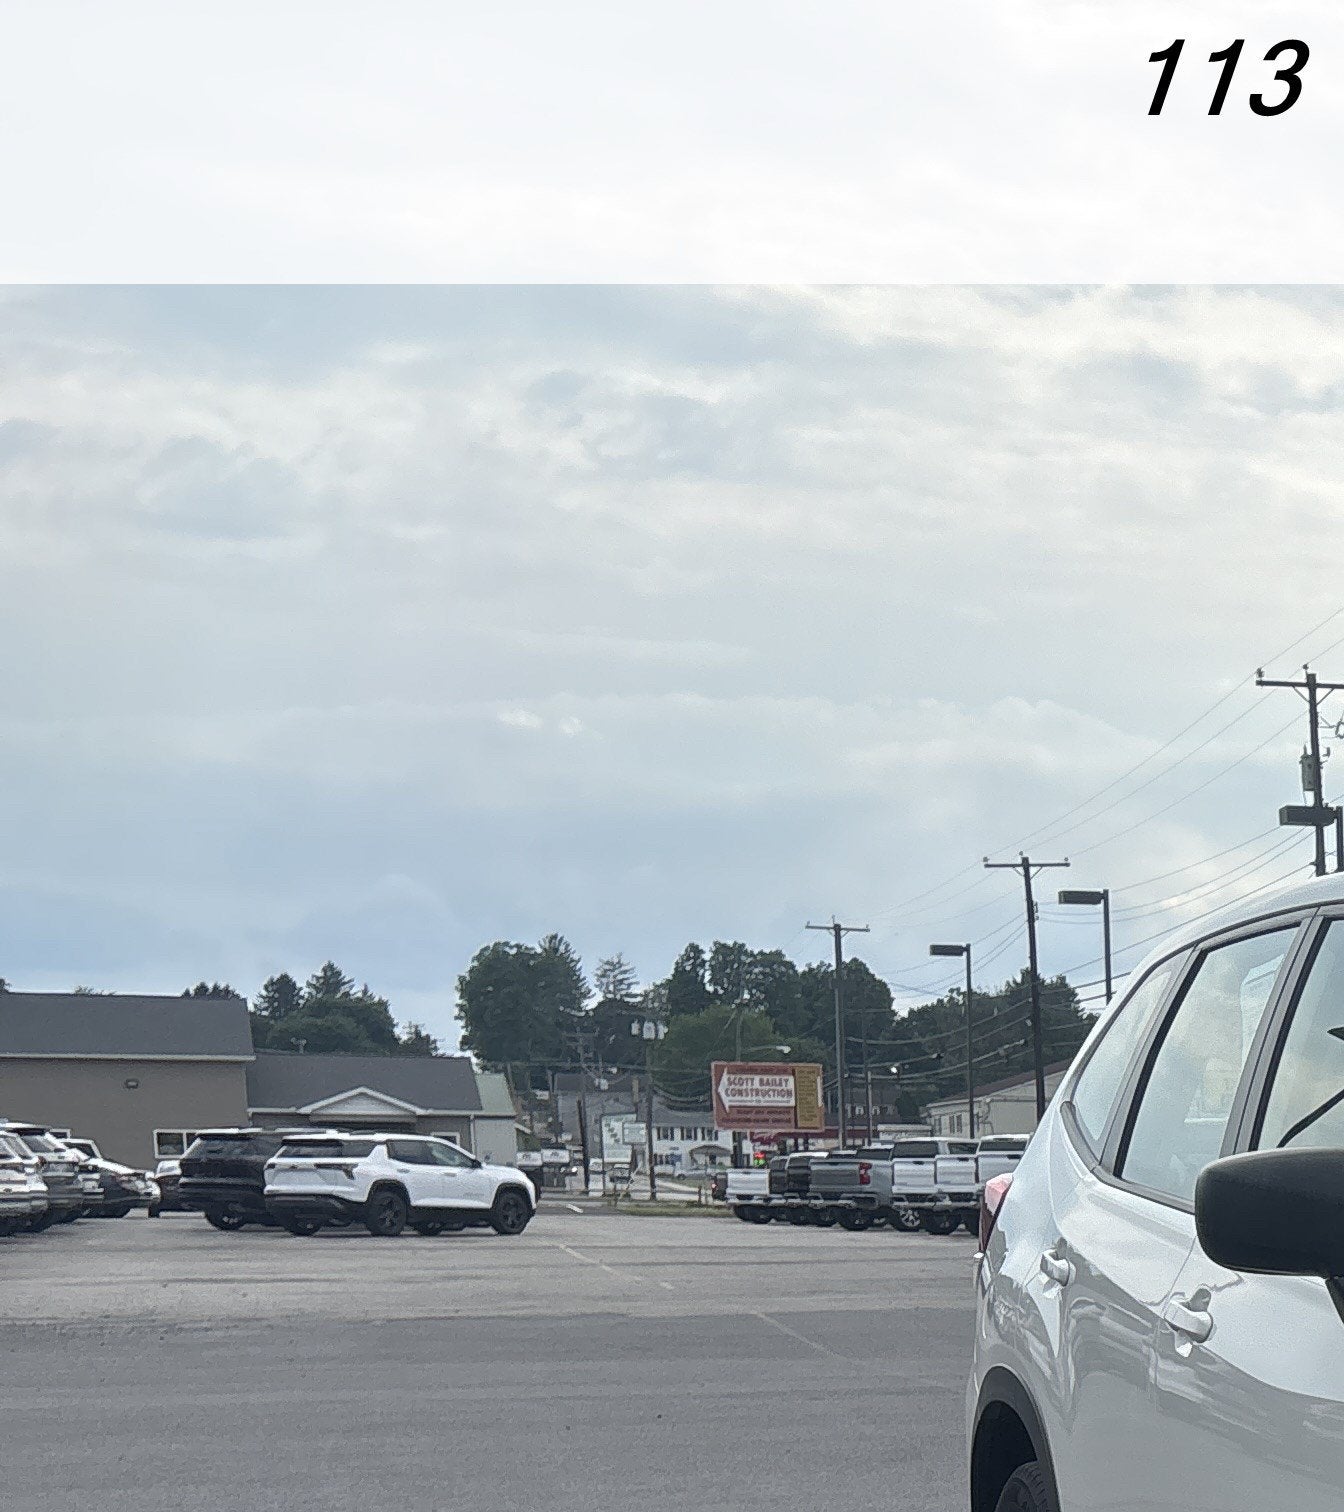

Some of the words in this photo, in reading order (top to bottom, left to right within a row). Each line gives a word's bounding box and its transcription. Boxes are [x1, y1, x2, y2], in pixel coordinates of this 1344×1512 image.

[726, 1076, 755, 1087] SCOTT
[758, 1077, 789, 1087] BAILEY
[724, 1087, 793, 1099] CONSTRUCTION
